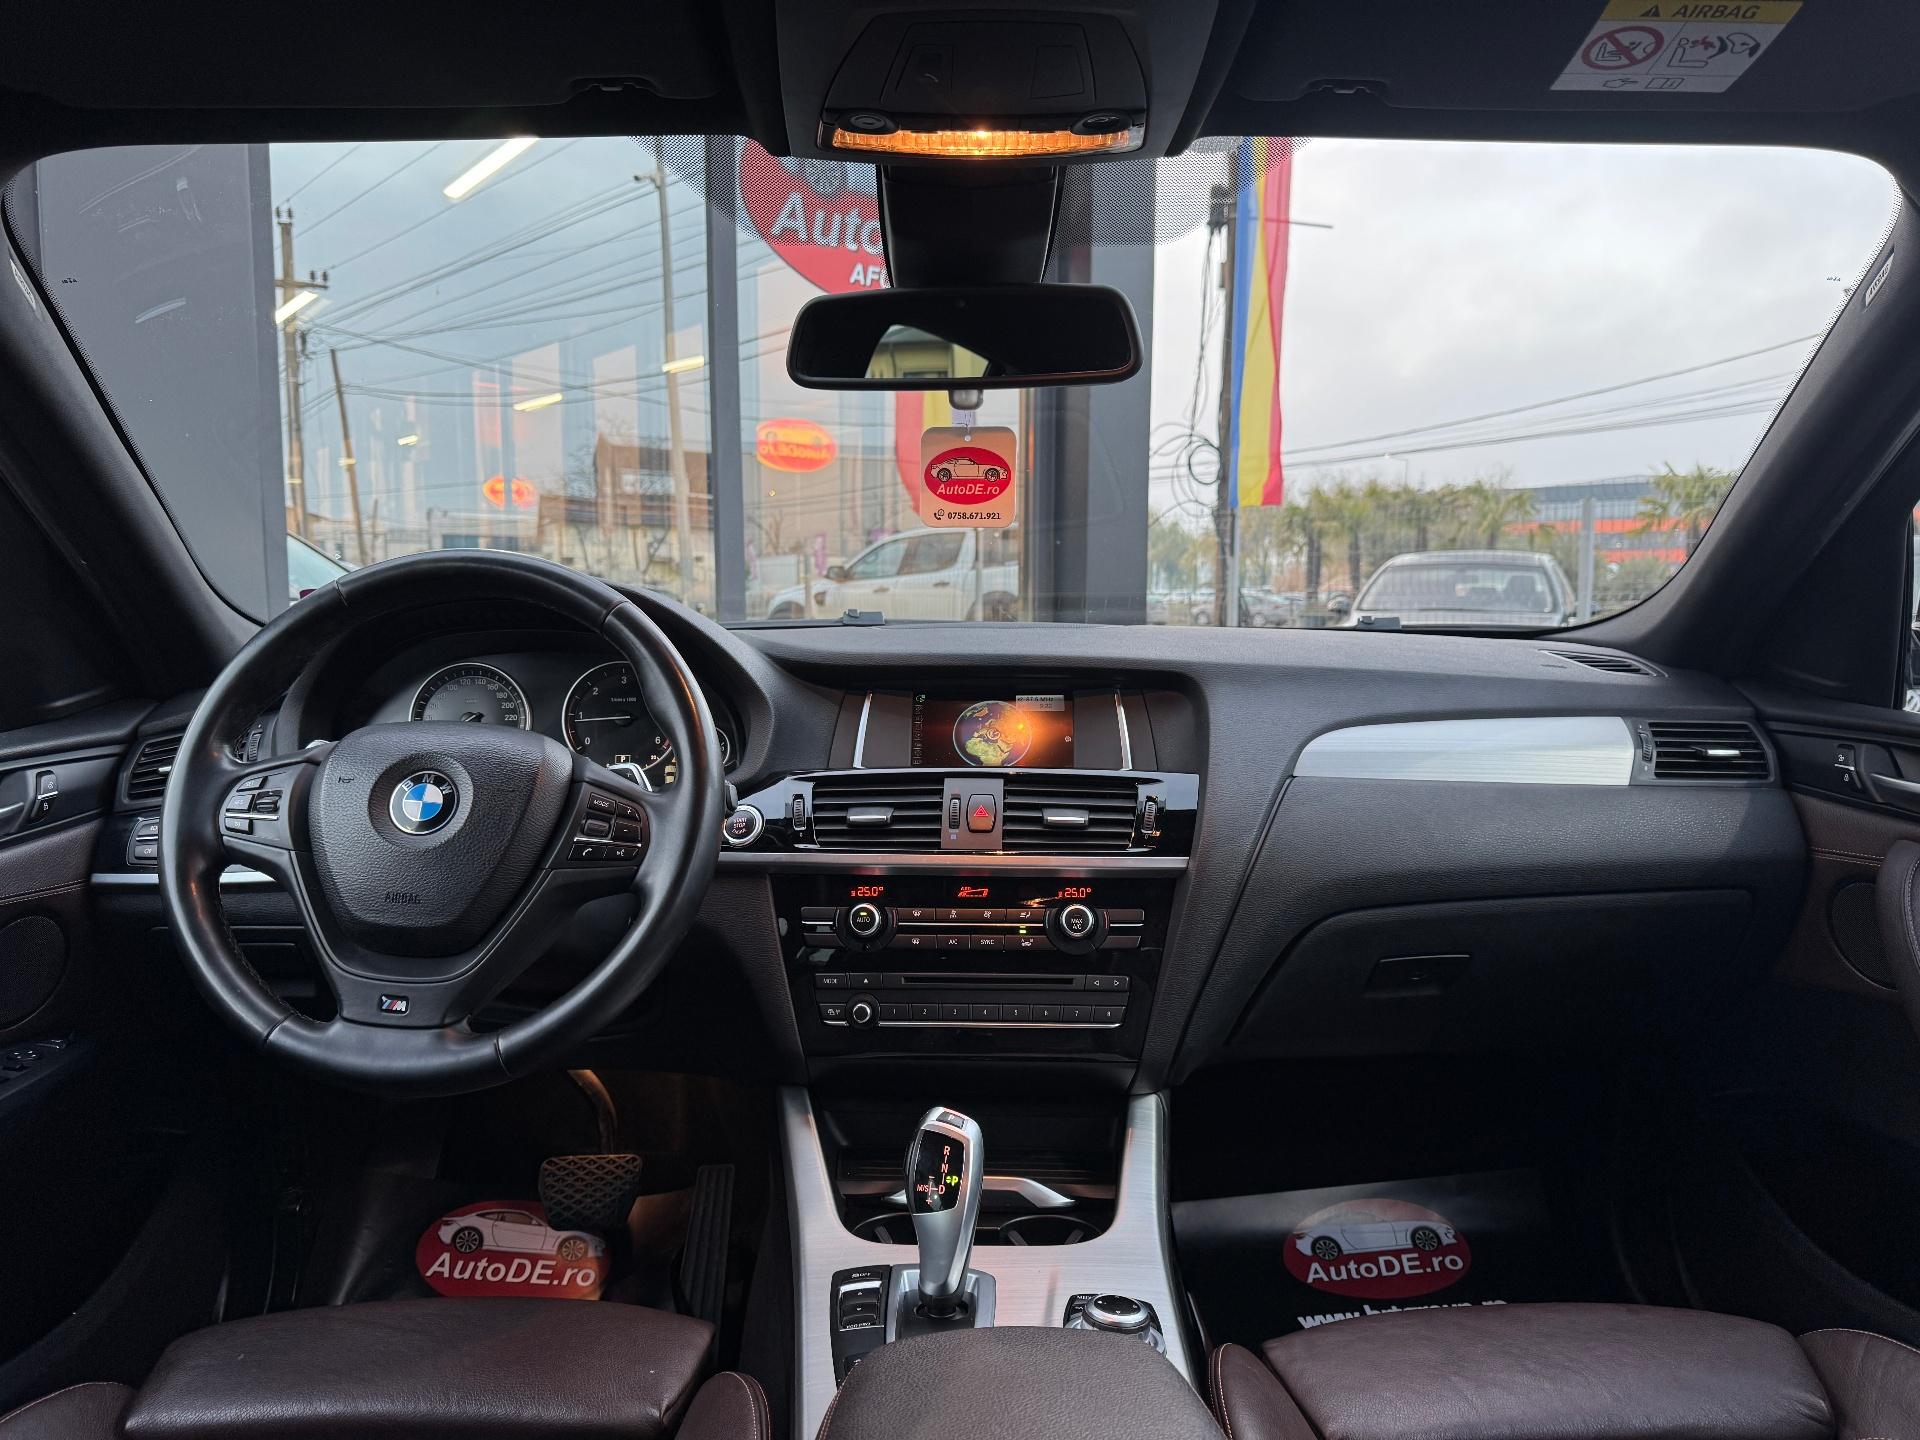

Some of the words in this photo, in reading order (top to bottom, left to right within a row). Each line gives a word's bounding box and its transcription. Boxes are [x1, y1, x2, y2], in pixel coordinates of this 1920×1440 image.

[1671, 4, 1761, 19] AIRBAG
[936, 483, 1000, 495] AutoDE.ro
[947, 512, 1001, 520] 0758.671.921
[592, 687, 599, 695] 2
[584, 737, 591, 745] 0
[655, 736, 661, 745] 6
[401, 773, 454, 795] BMW
[944, 1145, 951, 1156] R
[941, 1163, 949, 1173] N
[952, 1175, 959, 1187] P
[938, 1184, 946, 1195] D
[425, 1252, 597, 1288] AutoDE.ro
[1306, 1252, 1464, 1284] AutoDE.ro
